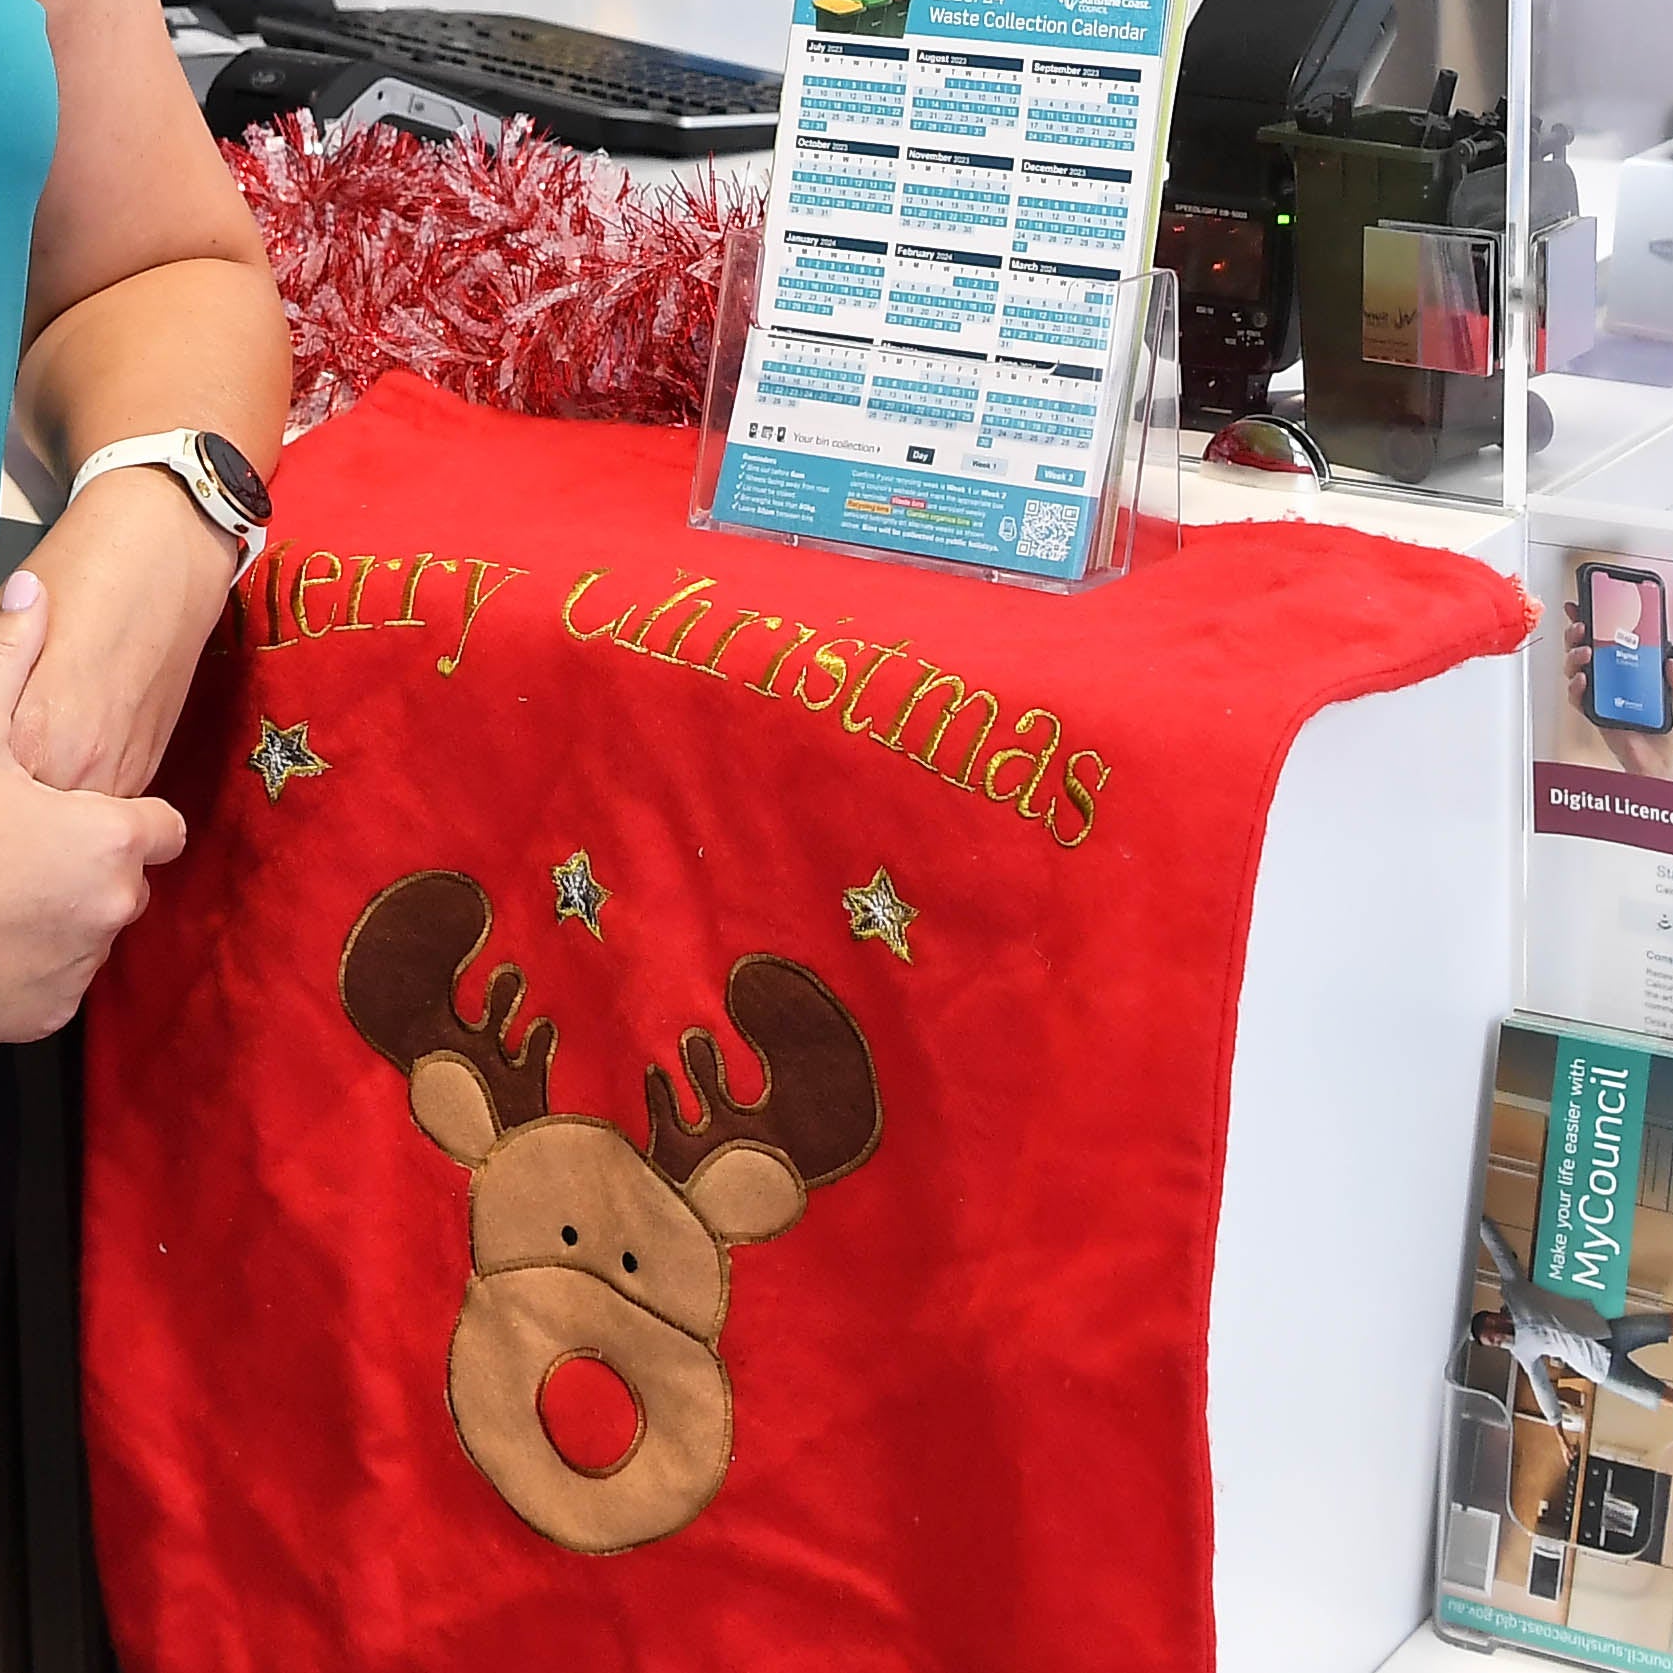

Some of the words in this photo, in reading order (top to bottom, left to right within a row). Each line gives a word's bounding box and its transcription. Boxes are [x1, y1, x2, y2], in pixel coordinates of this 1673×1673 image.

[1078, 5, 1109, 15] COUNCIL
[929, 7, 980, 27] Waste
[984, 12, 1068, 35] Collection
[1071, 19, 1149, 41] Calendar
[809, 42, 826, 53] July
[919, 52, 949, 64] August
[951, 56, 967, 65] 2023
[1034, 63, 1081, 76] September
[1082, 69, 1100, 77] 2023
[797, 139, 831, 150] October
[832, 143, 848, 151] 2023
[909, 149, 952, 163] November
[953, 156, 970, 165] 2023
[1024, 162, 1068, 175] December
[1069, 168, 1086, 176] 2023
[786, 233, 819, 247] January
[820, 239, 836, 247] 2024
[897, 246, 935, 261] February
[936, 252, 953, 261] 2024
[1011, 260, 1039, 272] March
[1040, 264, 1057, 274] 2024
[793, 432, 814, 444] Your
[816, 434, 830, 446] bin
[832, 440, 875, 454] collection
[912, 450, 929, 463] Day
[972, 460, 991, 470] Week
[1044, 469, 1067, 482] Week
[561, 566, 1113, 849] Christmas
[1549, 786, 1609, 816] Digital
[1568, 1058, 1586, 1097] with
[1565, 1101, 1582, 1155] easier
[1557, 1157, 1576, 1186] life
[1571, 1067, 1630, 1291] MyCouncil
[1555, 1188, 1572, 1230] your
[1548, 1233, 1568, 1281] Make
